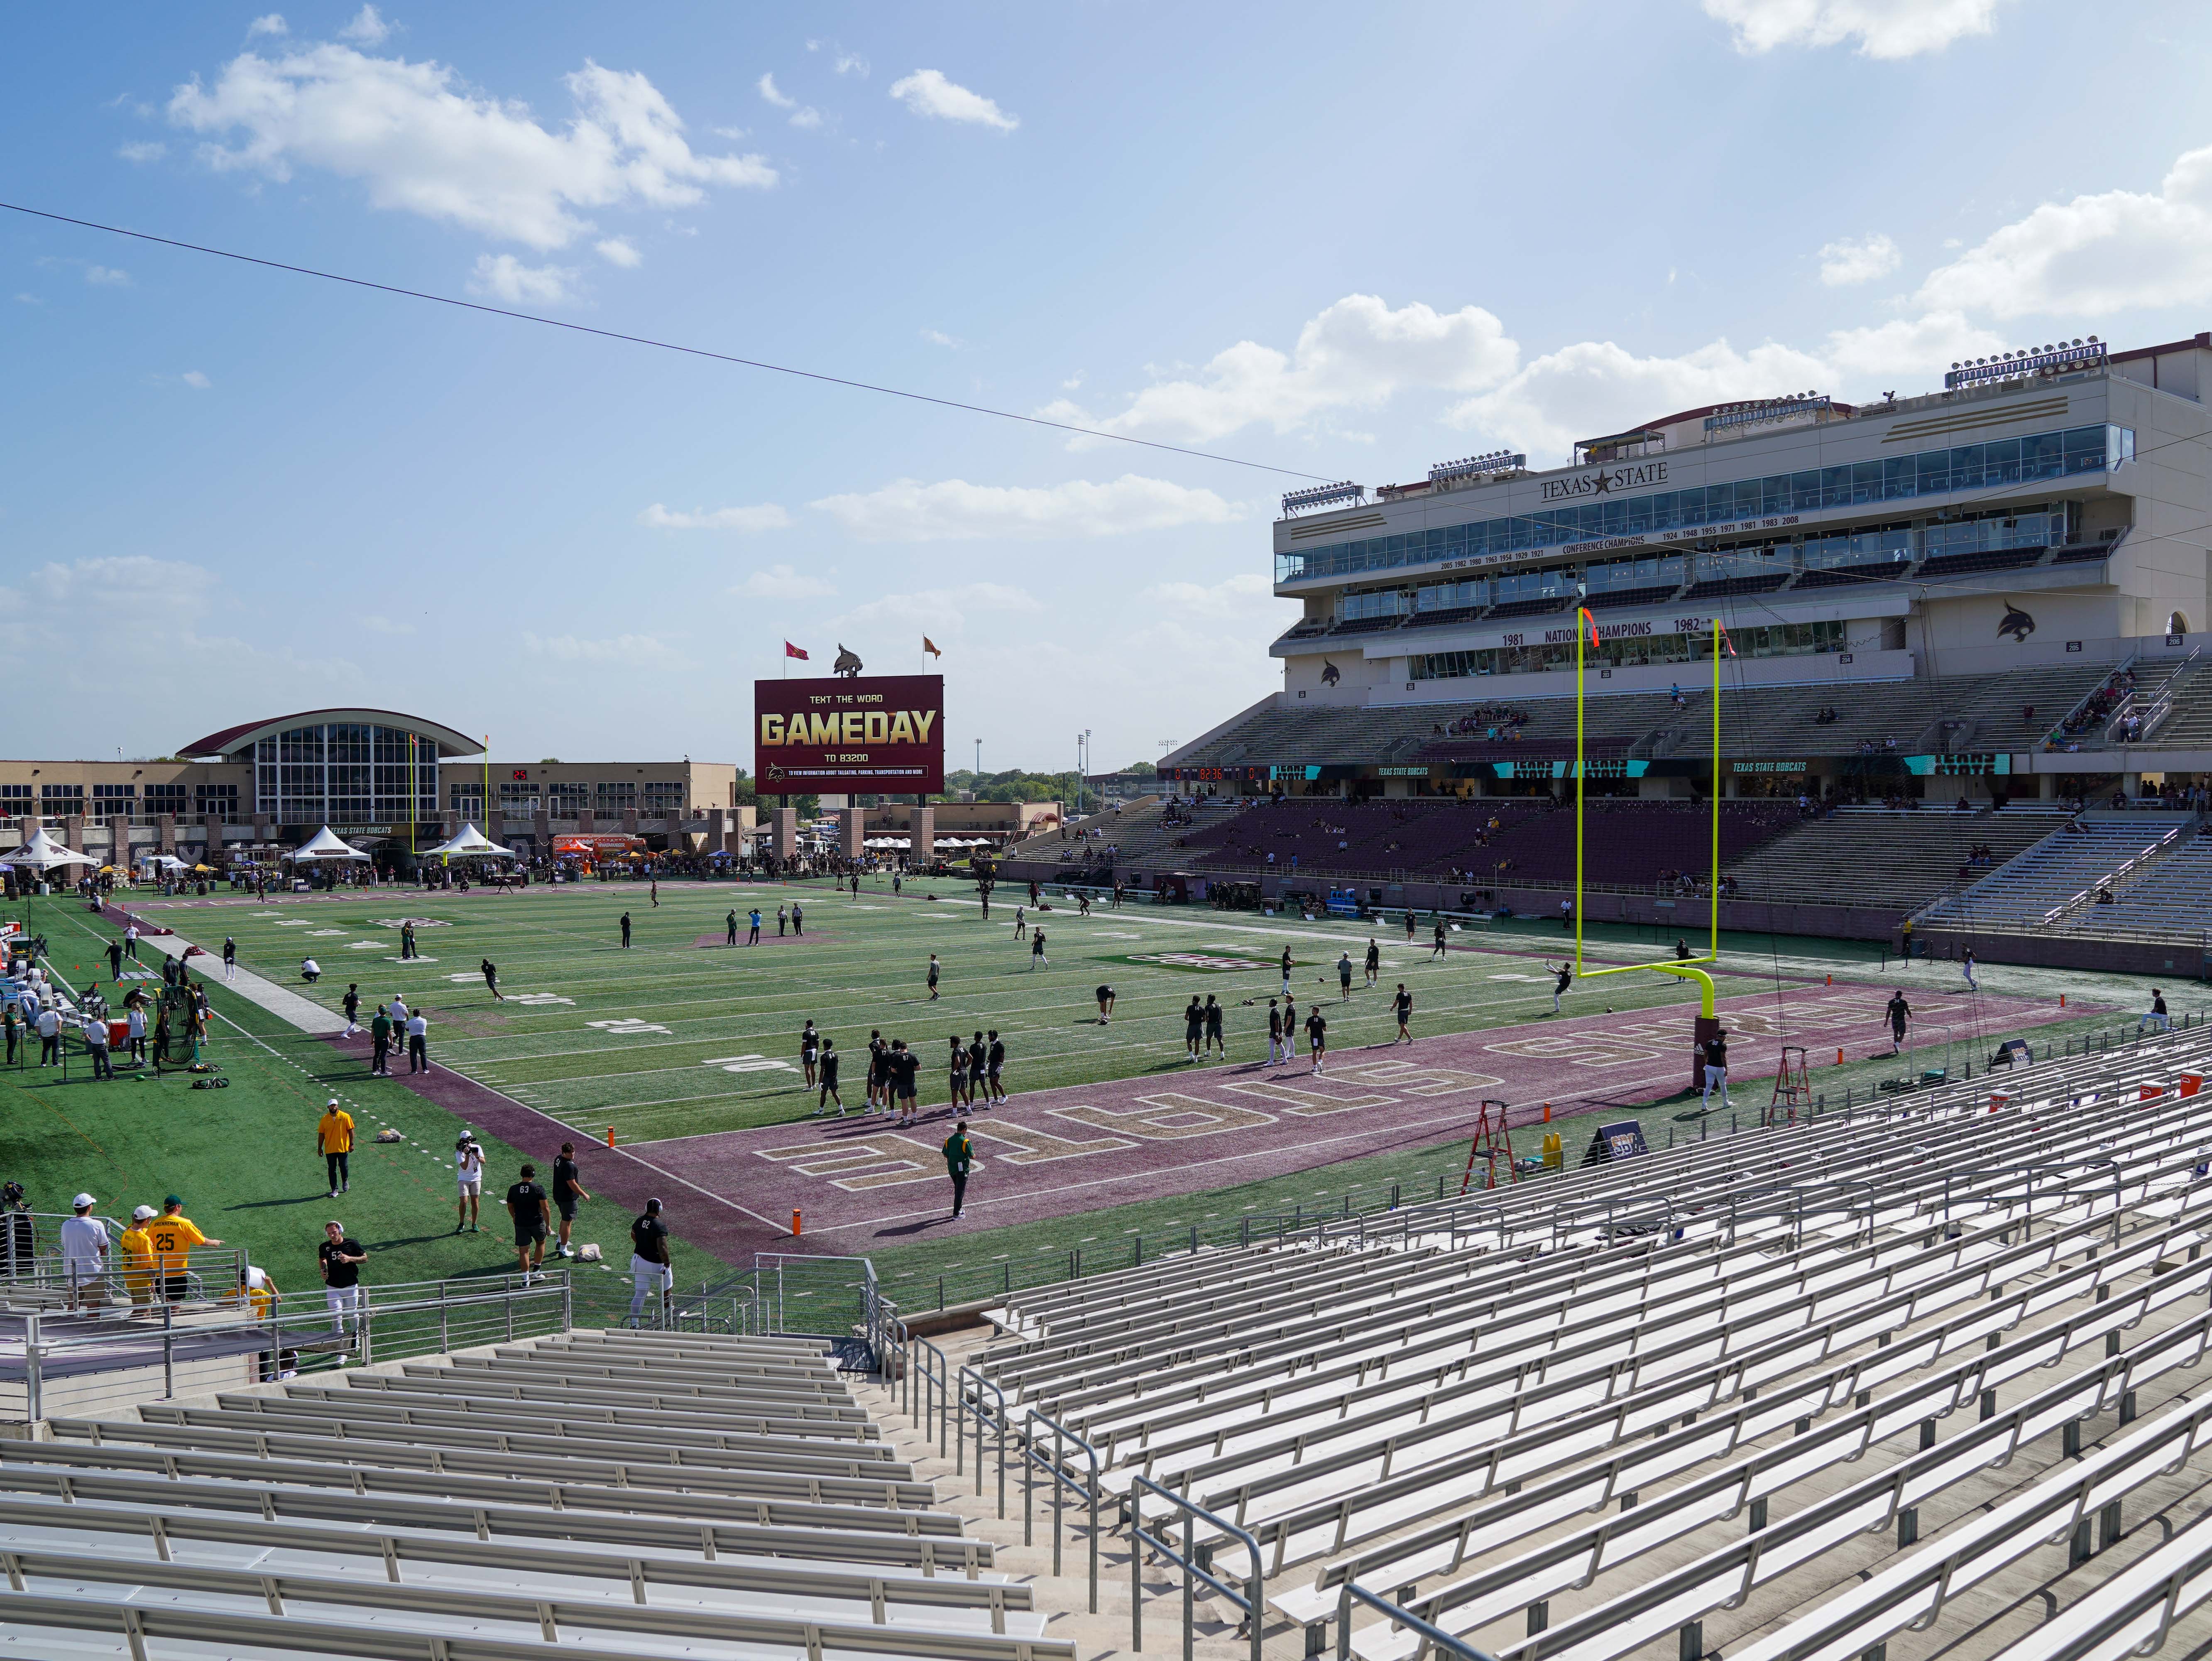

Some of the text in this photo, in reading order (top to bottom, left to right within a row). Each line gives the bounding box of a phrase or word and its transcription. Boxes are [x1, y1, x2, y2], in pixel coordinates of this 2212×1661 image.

[1541, 462, 1668, 498] TEXAS STATE
[1683, 529, 1697, 538] 1948
[1702, 527, 1716, 535] 1955
[1720, 524, 1735, 533] 1971
[1740, 522, 1756, 530] 1981
[1762, 519, 1777, 527] 1983
[1782, 516, 1798, 524] 2008
[1563, 536, 1644, 554] CONFERENCE CHAMPIONS
[1503, 634, 1523, 646] 1981
[1595, 622, 1651, 639] HAMPIONS
[1674, 618, 1699, 632] 1982
[810, 696, 832, 704] TEXT
[761, 710, 936, 746] GAMEDAY
[514, 770, 526, 779] 25
[1175, 768, 1254, 779] 0 82:36 0
[1733, 762, 1806, 772] TEXAS STATE BOBCATS
[585, 1018, 668, 1034] 20
[702, 1054, 793, 1072] 10
[751, 1060, 1506, 1192] STATE
[641, 1220, 650, 1229] 62
[156, 1233, 174, 1251] 25
